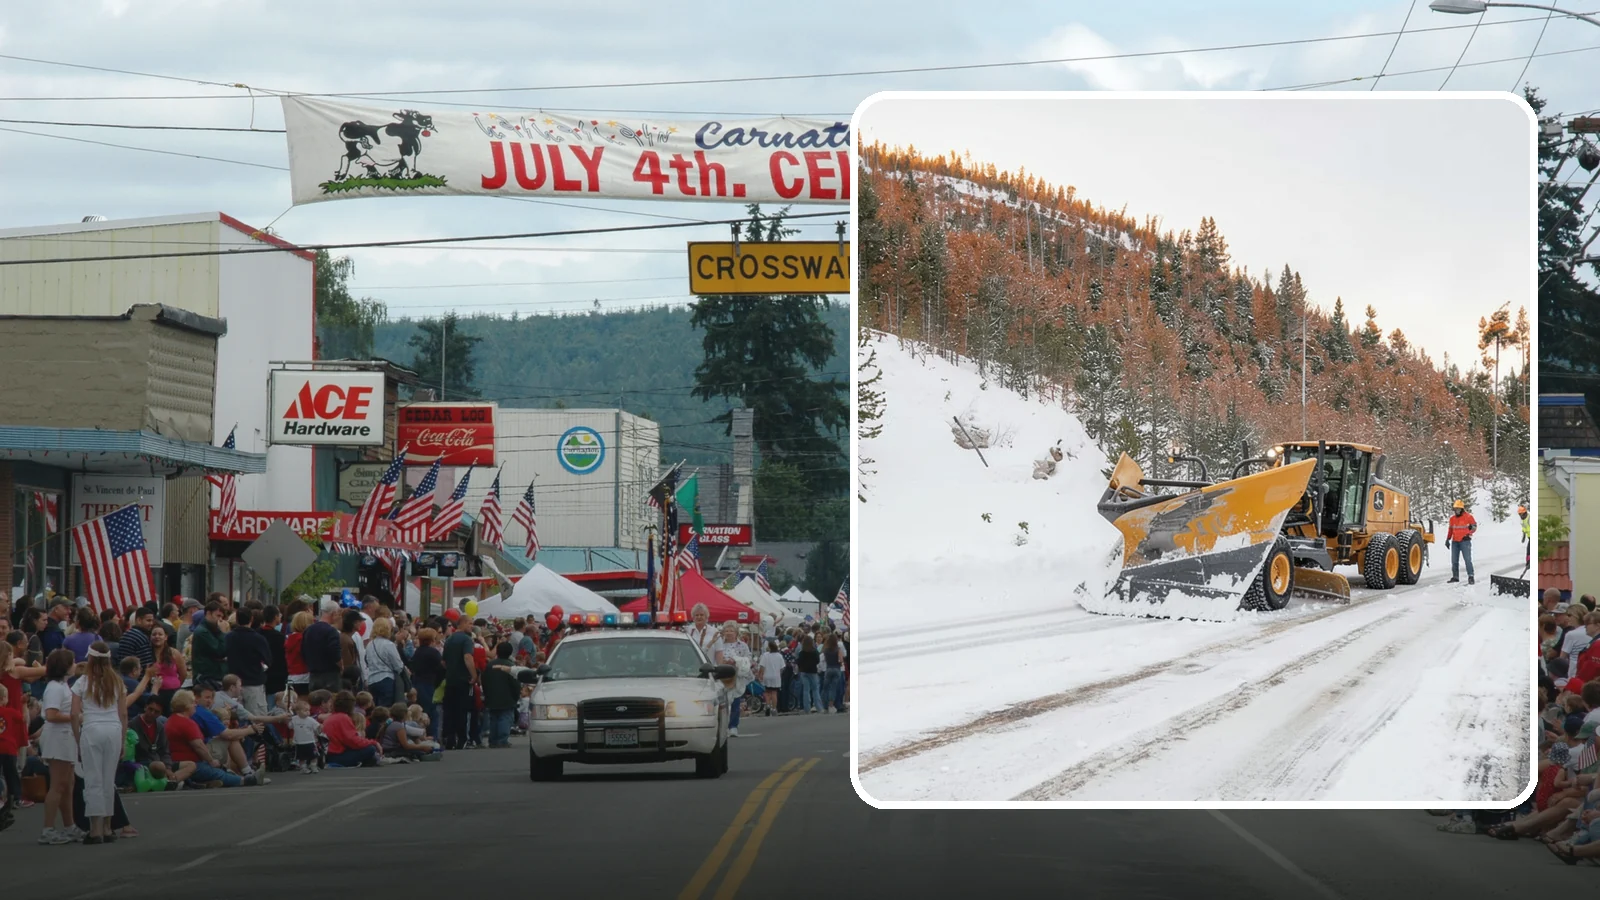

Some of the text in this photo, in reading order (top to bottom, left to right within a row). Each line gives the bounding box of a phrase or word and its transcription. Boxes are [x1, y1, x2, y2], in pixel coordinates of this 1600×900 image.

[481, 141, 605, 193] JULY
[632, 150, 746, 198] 4th.
[697, 254, 850, 280] CROSSWA
[283, 380, 374, 420] ACE
[405, 409, 452, 422] CEDAR
[283, 421, 371, 436] Hardware
[416, 428, 477, 447] Coca-Cola
[353, 467, 383, 480] Simpl
[95, 485, 124, 495] Vincent
[126, 486, 136, 495] de
[137, 486, 155, 496] Paul
[212, 516, 331, 536] HARDARE
[688, 526, 742, 535] CRNATION
[699, 535, 730, 543] GLASS
